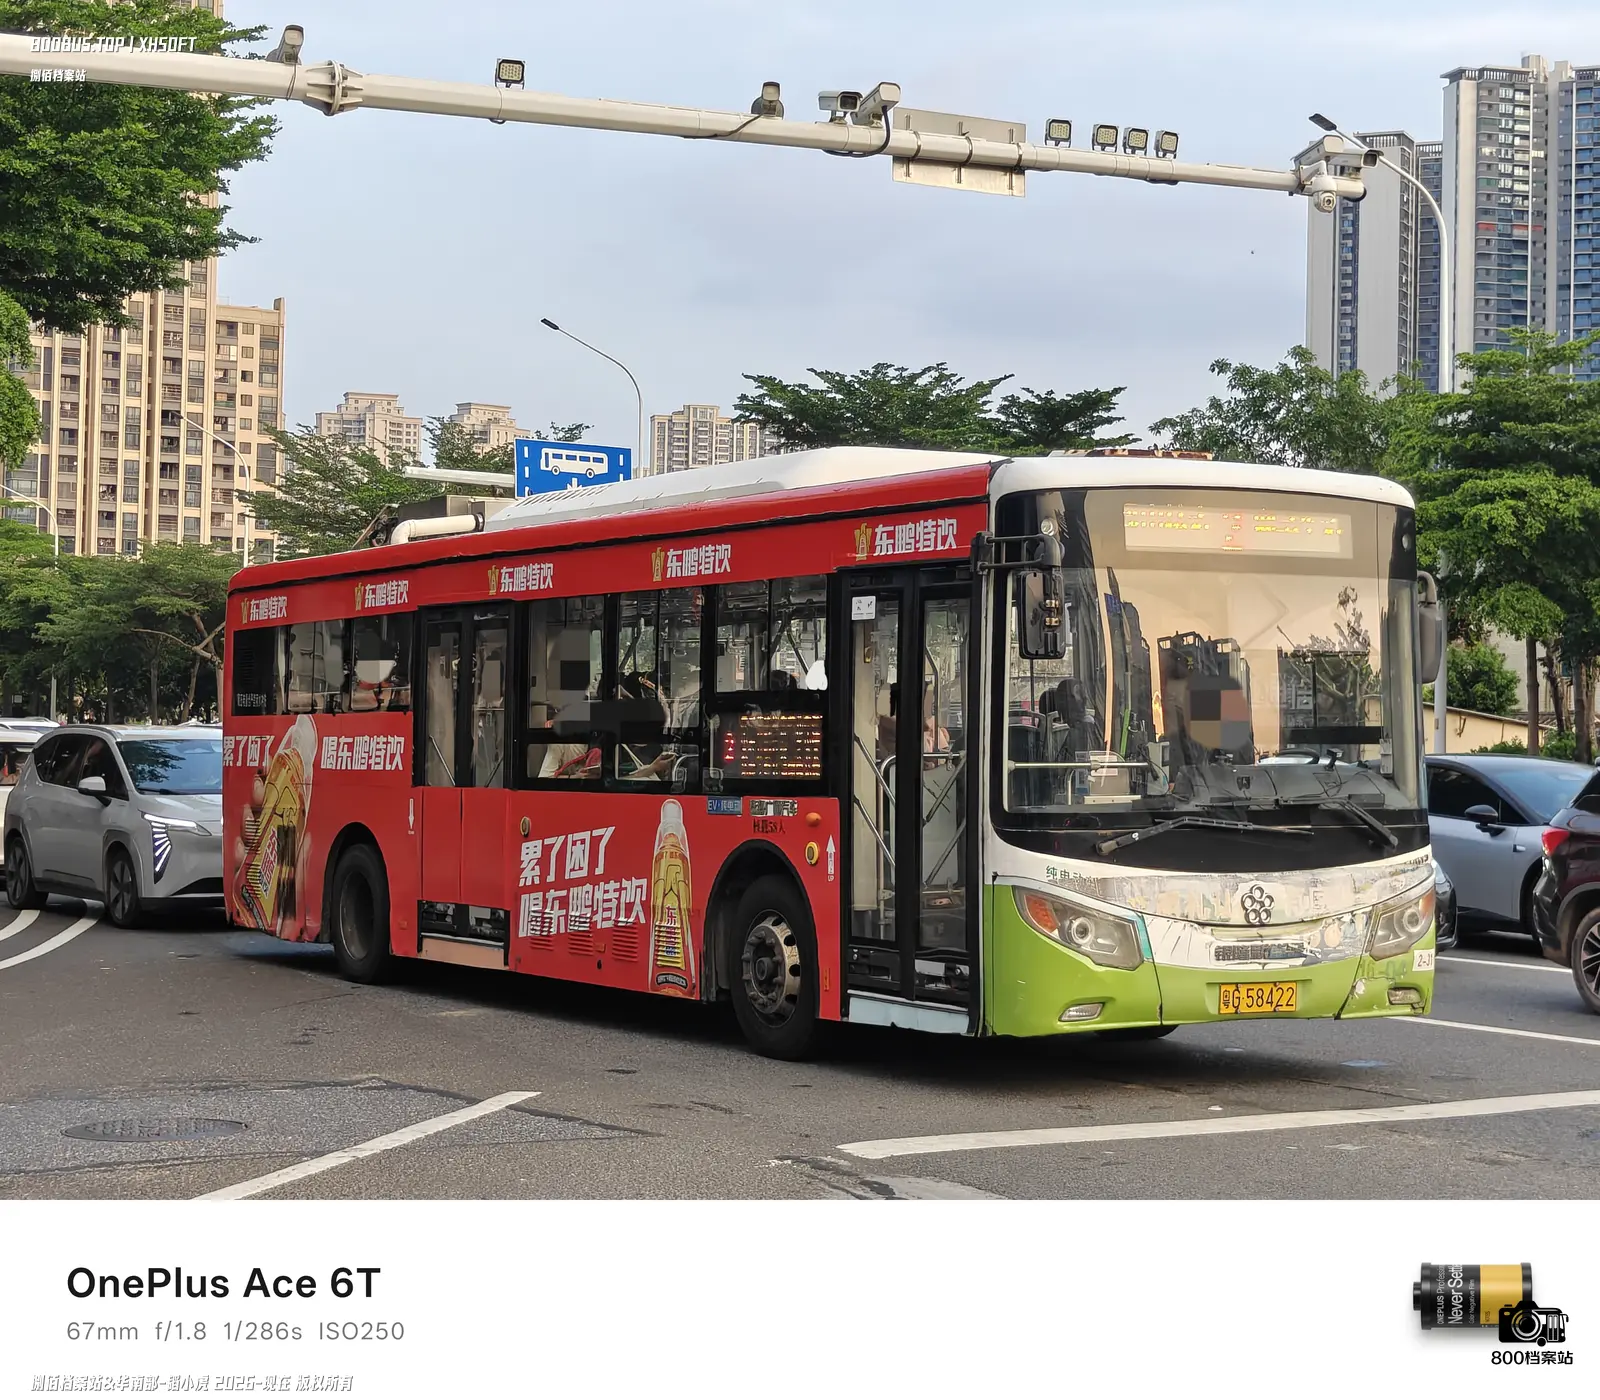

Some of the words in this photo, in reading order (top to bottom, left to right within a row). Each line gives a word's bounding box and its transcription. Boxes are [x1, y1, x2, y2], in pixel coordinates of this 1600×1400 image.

[873, 518, 957, 556] 东鹏特饮
[500, 563, 554, 593] 东鹏特饮
[666, 544, 732, 578] 东鹏特饮
[249, 595, 288, 622] 东鹏特饮
[364, 580, 409, 608] 东鹏特饮
[223, 735, 275, 767] 累了困了
[320, 735, 405, 771] 喝东鹏特饮
[519, 826, 616, 887] 累了困了
[518, 876, 648, 938] 喝东鹏特饮
